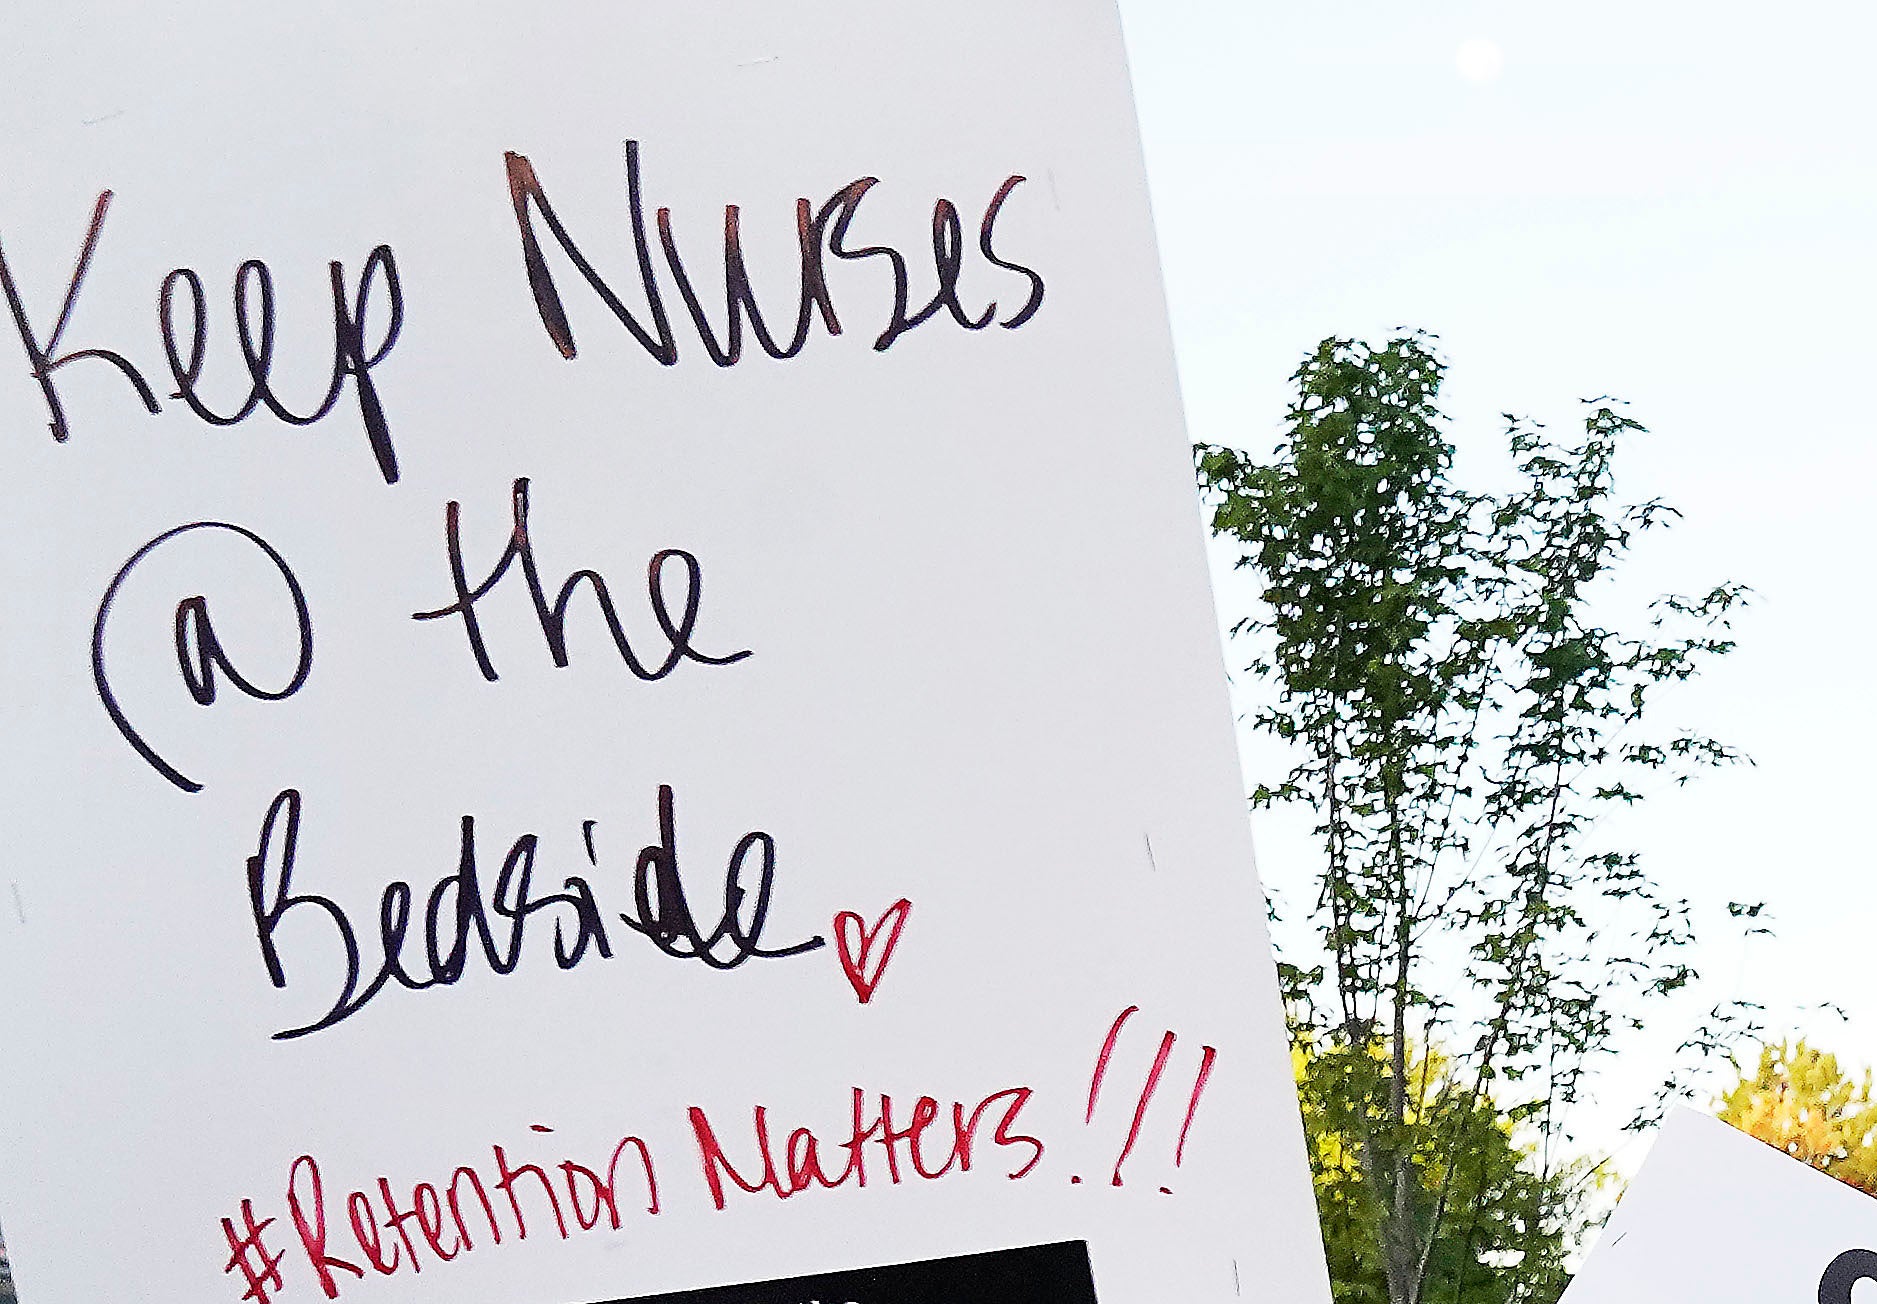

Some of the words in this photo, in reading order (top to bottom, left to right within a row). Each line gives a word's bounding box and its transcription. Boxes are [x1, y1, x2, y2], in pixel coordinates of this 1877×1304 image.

[0, 190, 405, 483] Keep
[504, 139, 1045, 367] Nurses
[412, 477, 754, 681] the
[246, 783, 825, 1041] Bedside
